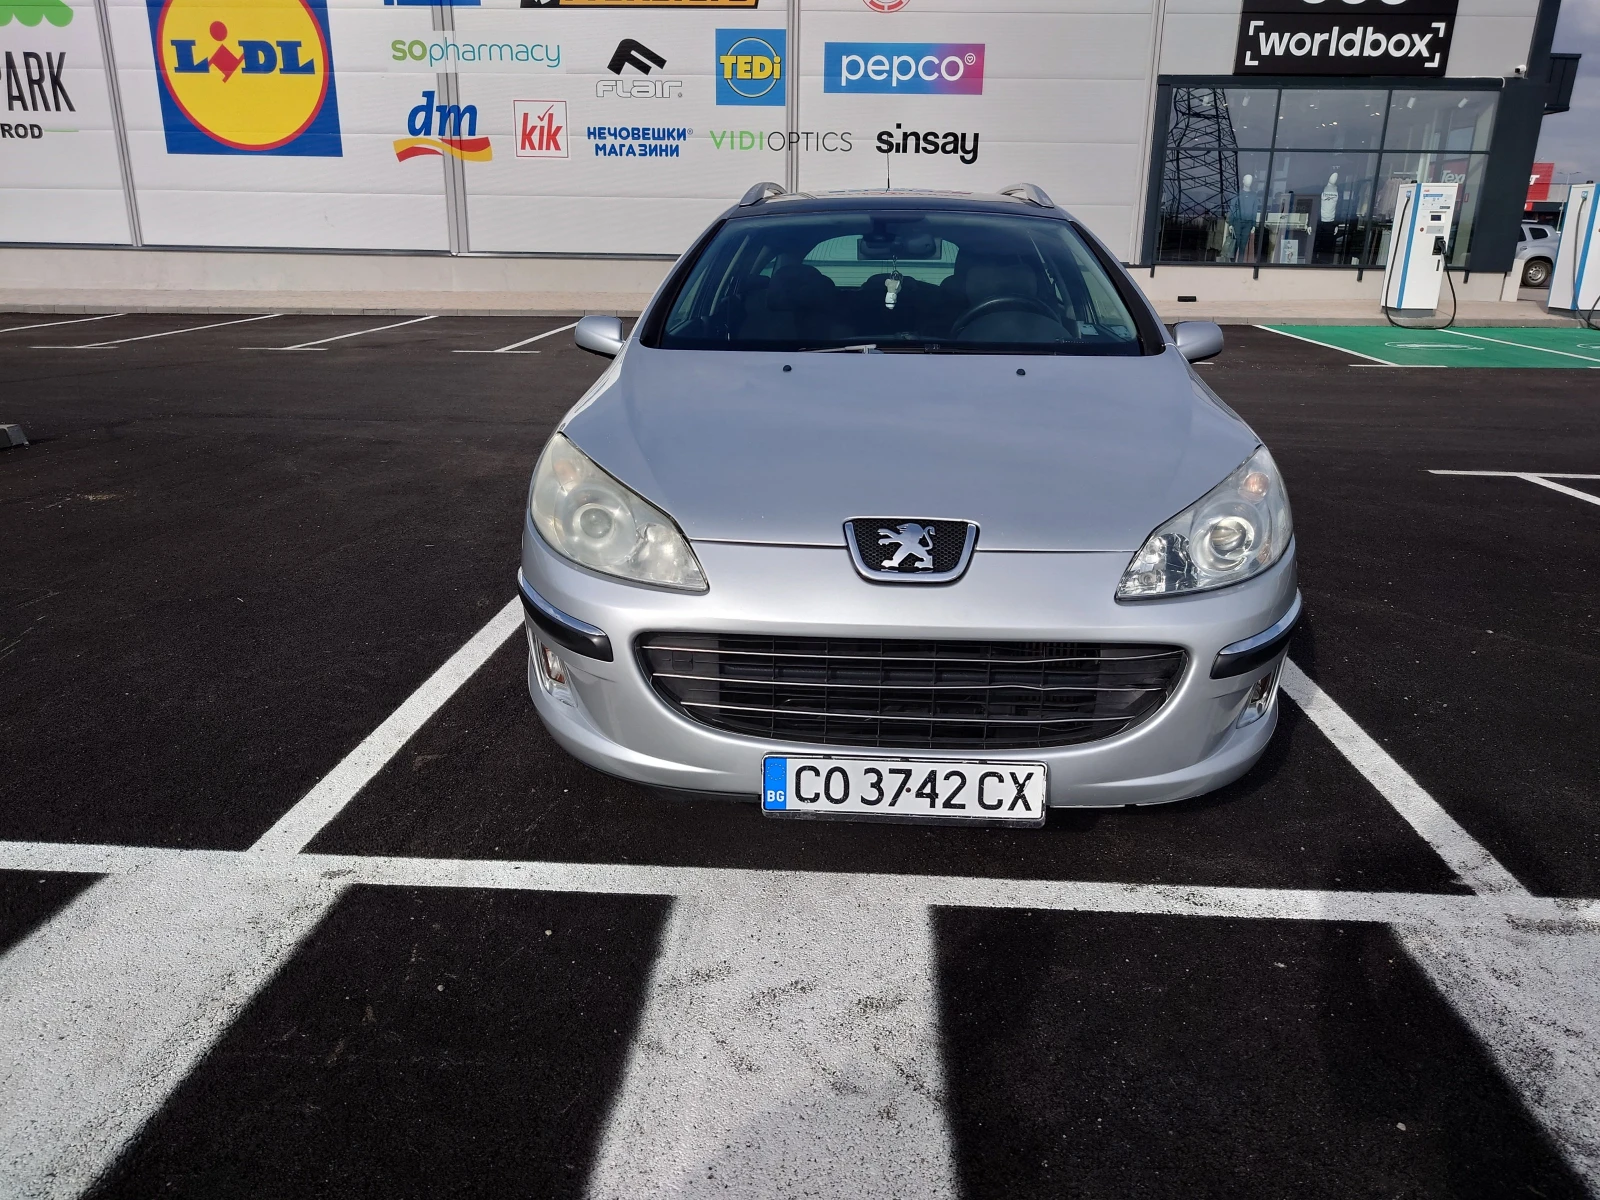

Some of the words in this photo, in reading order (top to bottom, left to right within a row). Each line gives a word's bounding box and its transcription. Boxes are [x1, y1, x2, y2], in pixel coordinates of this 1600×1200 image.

[391, 37, 561, 68] sopharmacy
[1258, 26, 1433, 58] worldbox
[0, 51, 76, 112] ARK
[841, 54, 964, 87] pepco
[407, 91, 478, 137] dm
[586, 126, 687, 142] НЕЧОВЕШКИ
[875, 123, 980, 165] sinsay
[594, 143, 681, 158] МАГАЗИНИ
[766, 789, 785, 803] BG
[793, 765, 850, 805] CO
[977, 771, 1035, 813] CX
